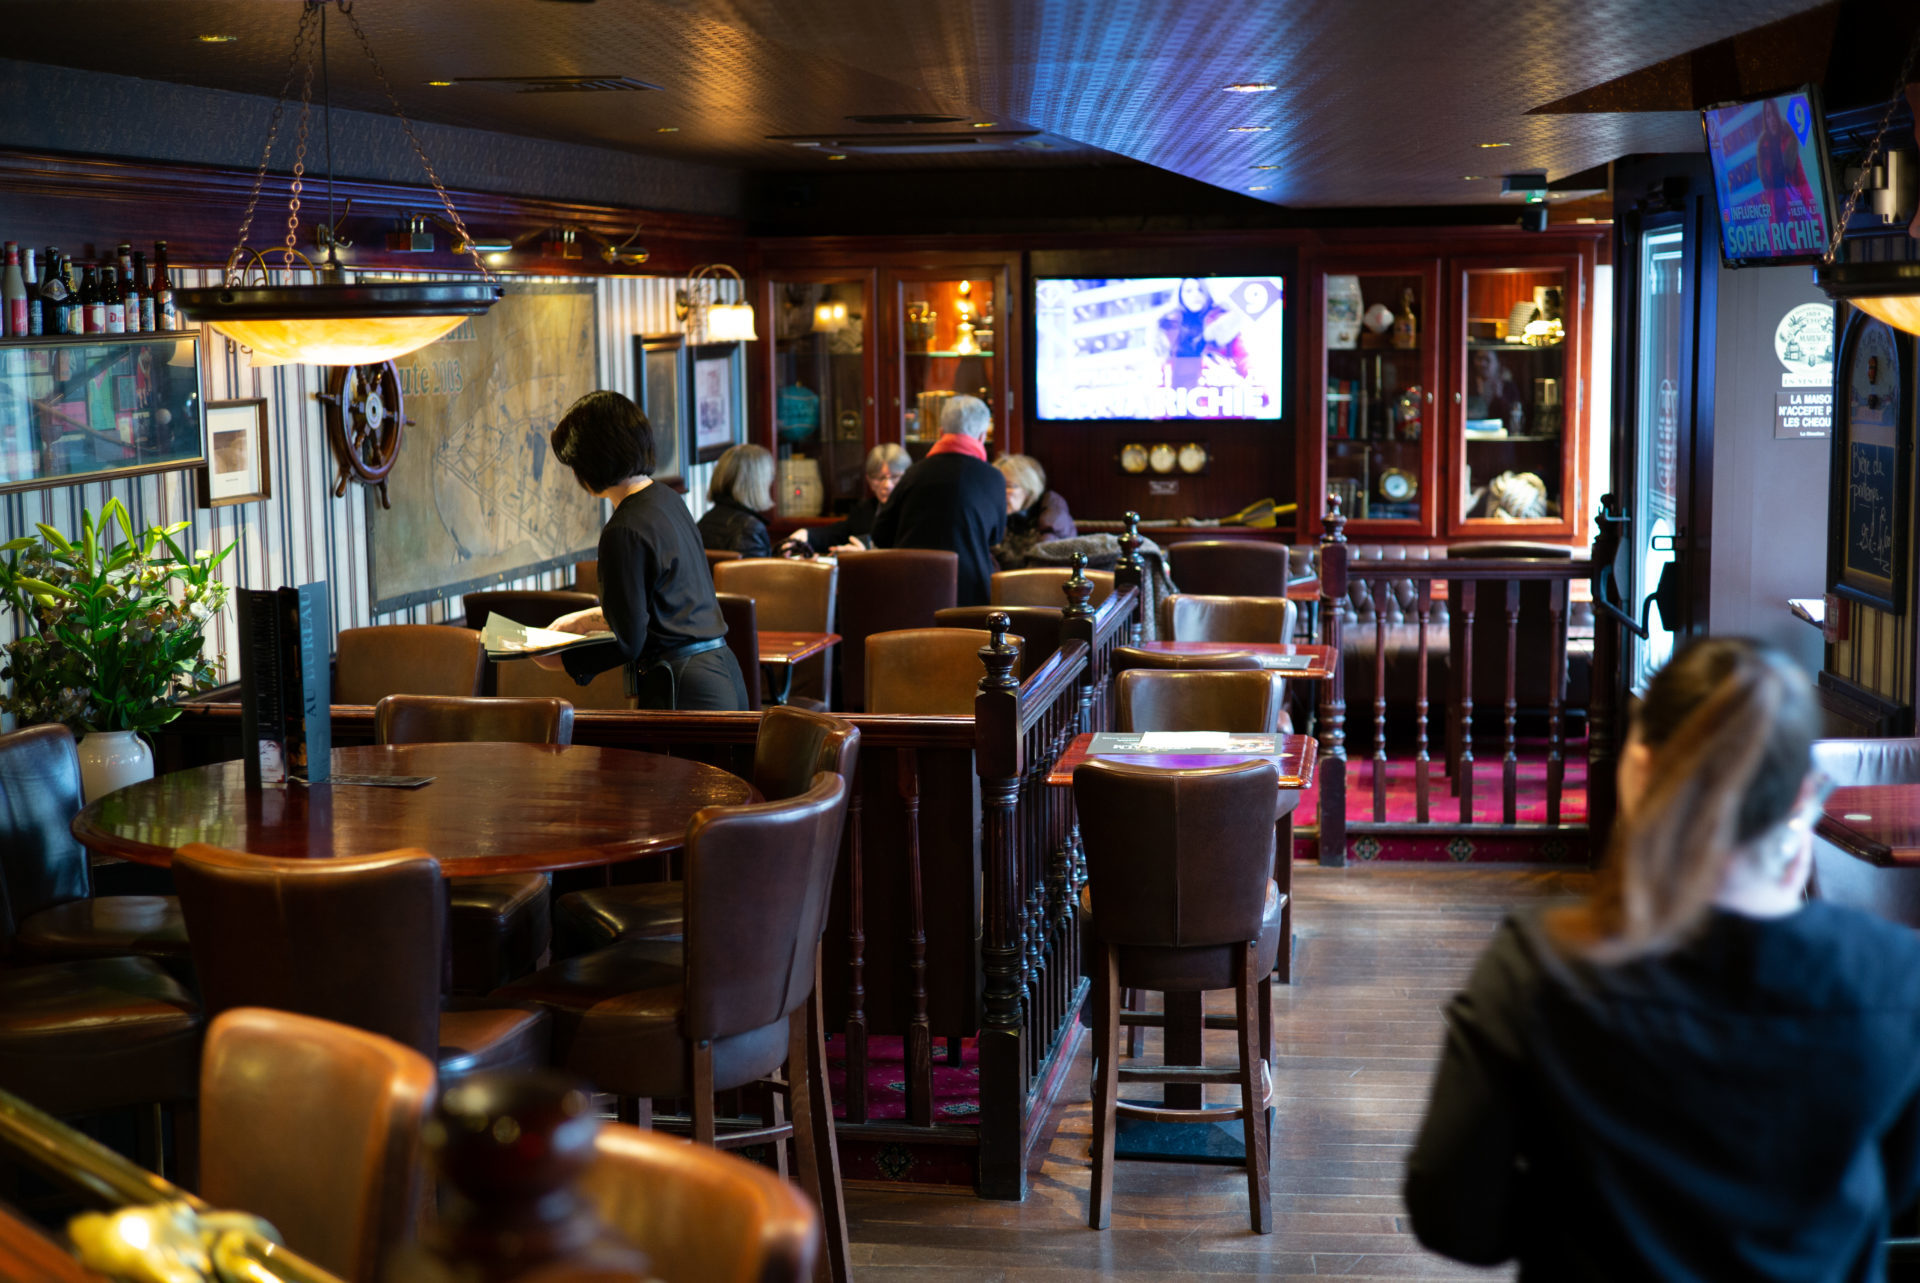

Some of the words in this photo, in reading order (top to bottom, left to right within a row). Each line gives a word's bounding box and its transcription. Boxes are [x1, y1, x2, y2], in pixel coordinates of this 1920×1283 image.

[1794, 102, 1806, 135] 9
[1730, 203, 1772, 220] INFLUENCER
[1728, 223, 1771, 253] SOFIA
[1771, 218, 1822, 251] RICHIE
[1243, 282, 1270, 315] 9
[432, 359, 464, 394] 2003
[1778, 405, 1824, 416] N'ACCEPTE
[1790, 394, 1802, 405] LA
[1804, 394, 1832, 405] MAISO
[1783, 417, 1800, 428] LES
[1801, 417, 1832, 428] CHEQU
[299, 590, 315, 680] BUREAU
[304, 688, 317, 718] AU
